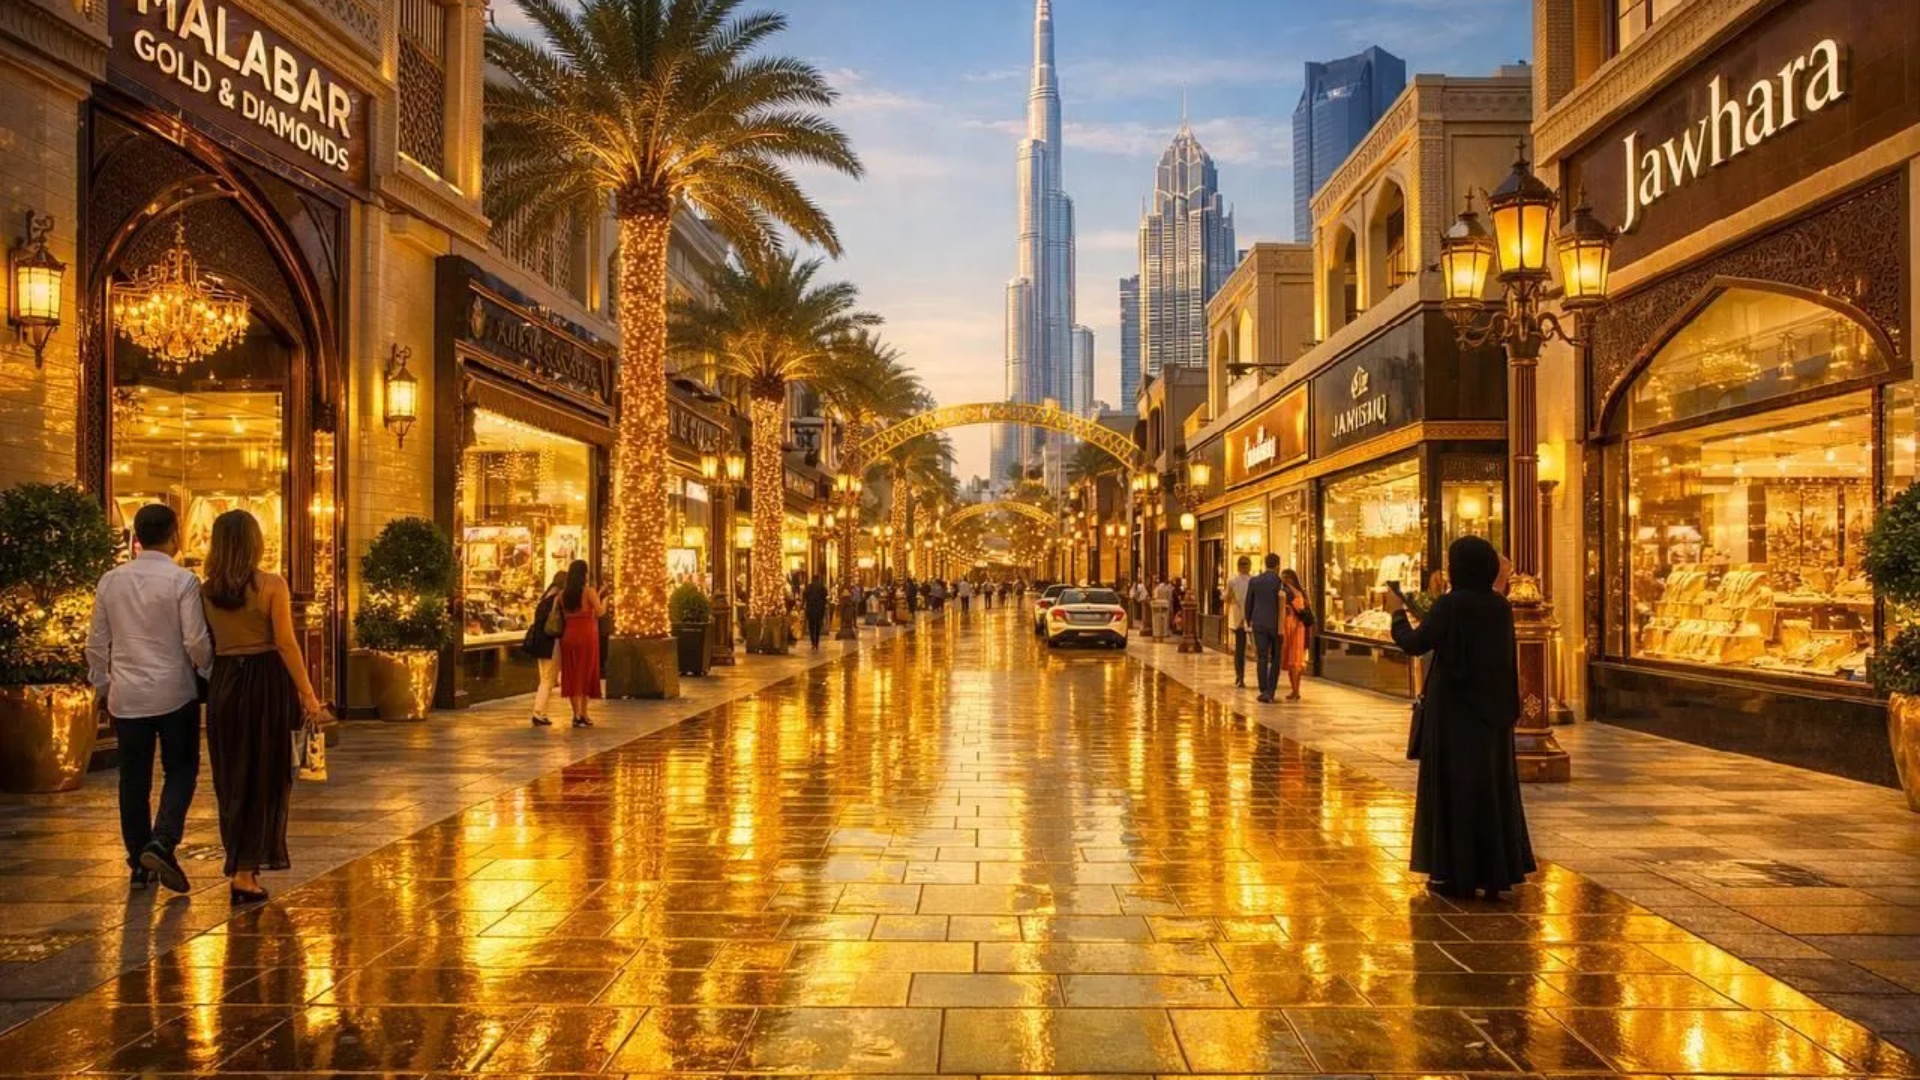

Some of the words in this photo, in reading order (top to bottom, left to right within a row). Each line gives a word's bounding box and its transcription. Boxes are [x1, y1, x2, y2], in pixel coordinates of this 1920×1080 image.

[134, 29, 211, 93] GOLD
[218, 78, 235, 110] &
[242, 90, 349, 172] DIAMONDS
[1619, 38, 1844, 234] Jawhara
